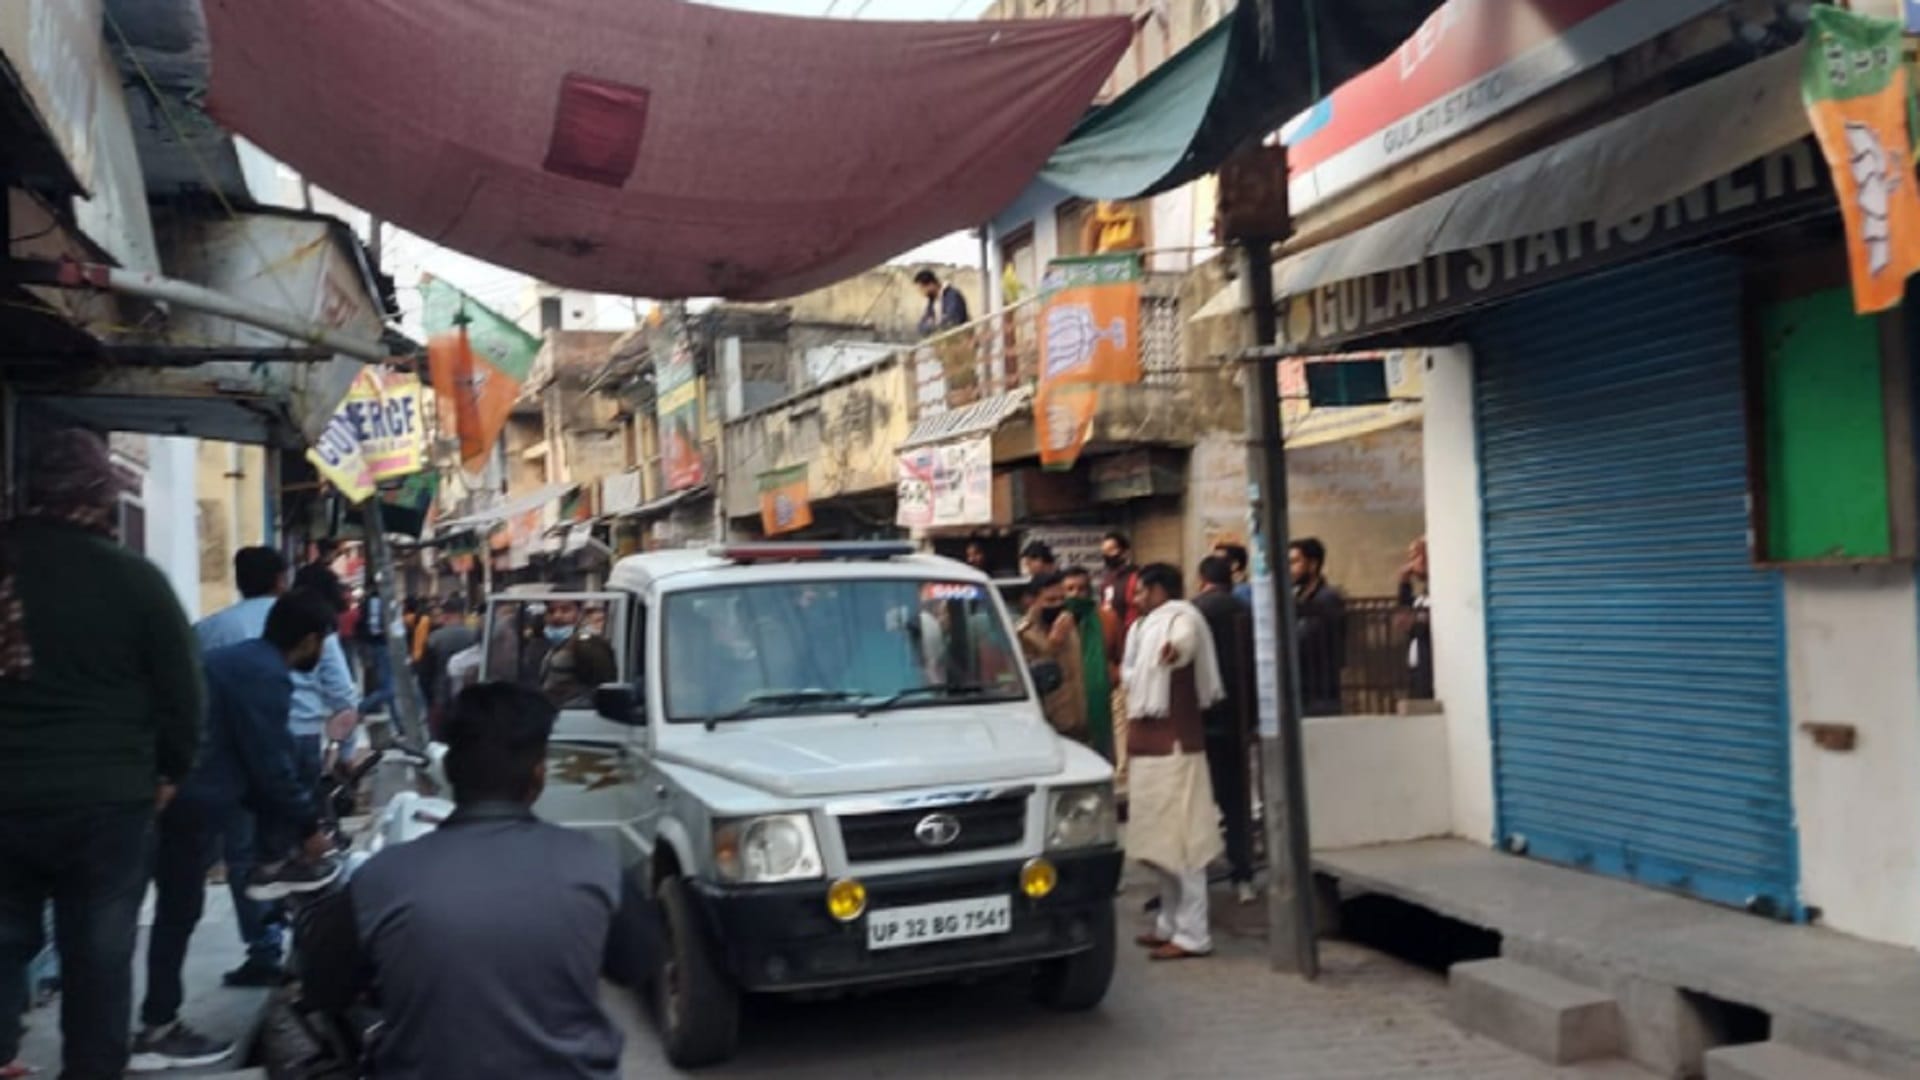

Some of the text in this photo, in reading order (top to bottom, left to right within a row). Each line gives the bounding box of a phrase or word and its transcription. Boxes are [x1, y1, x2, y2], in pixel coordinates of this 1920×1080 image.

[1383, 105, 1444, 154] GULATI
[873, 908, 1007, 942] UP 32 BG 7541
